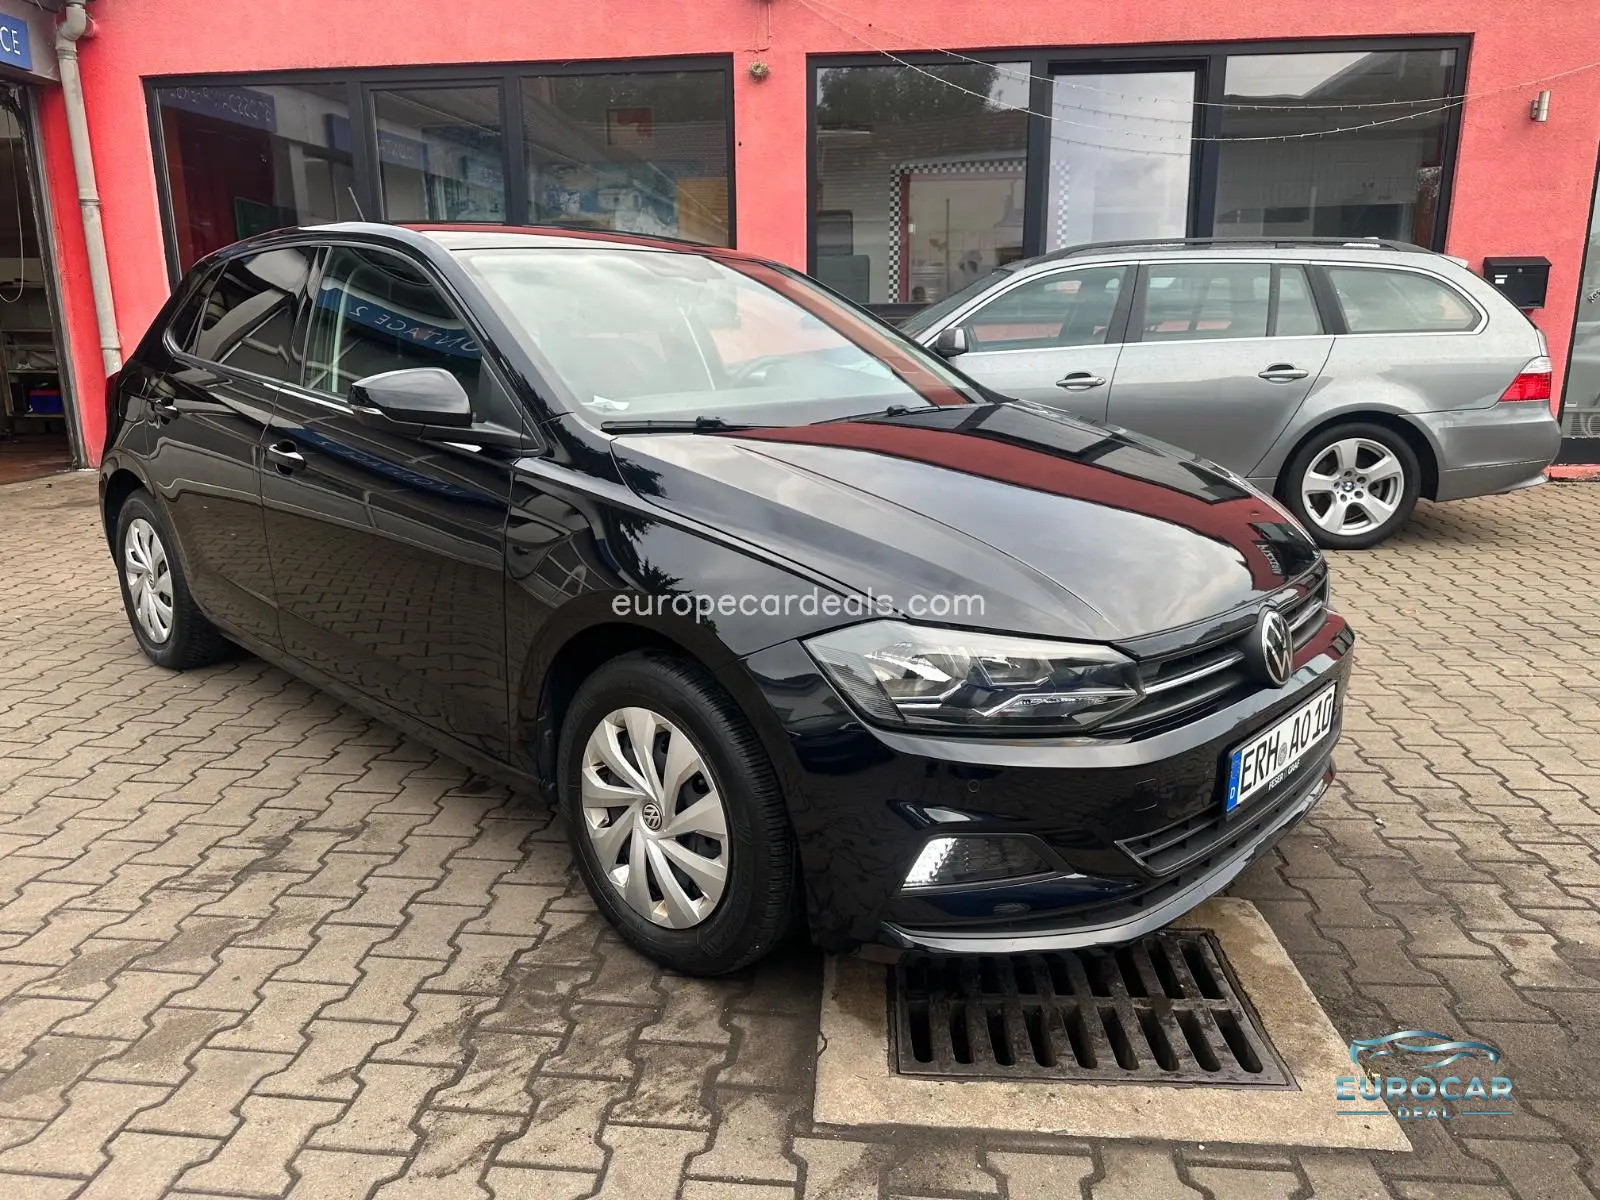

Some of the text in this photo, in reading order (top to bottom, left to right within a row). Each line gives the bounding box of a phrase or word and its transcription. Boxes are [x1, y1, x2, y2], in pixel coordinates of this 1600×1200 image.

[0, 26, 21, 55] CE
[1240, 730, 1280, 796] ERH
[1288, 709, 1311, 759] AO
[1229, 786, 1236, 800] D
